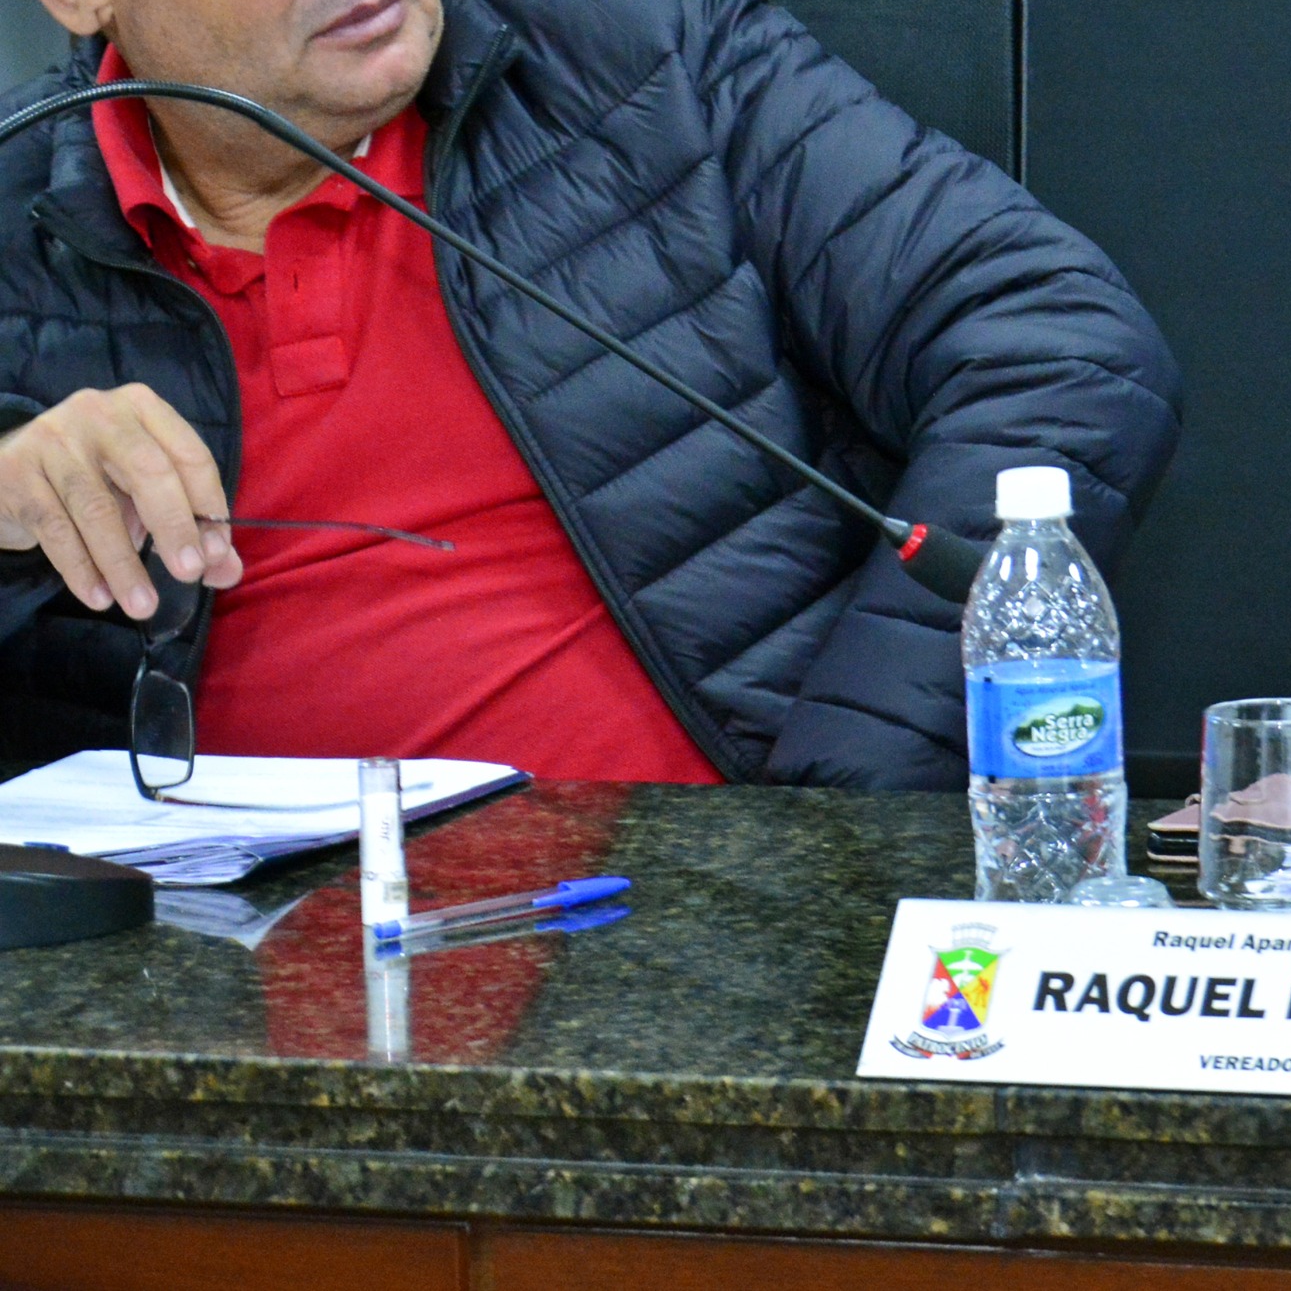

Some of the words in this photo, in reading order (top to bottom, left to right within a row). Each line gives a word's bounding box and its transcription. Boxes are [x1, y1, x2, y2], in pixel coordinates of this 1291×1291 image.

[1045, 714, 1094, 730] Serra
[1031, 727, 1088, 745] Negra
[1153, 931, 1235, 951] Raquel
[1033, 971, 1266, 1022] RAQUEL
